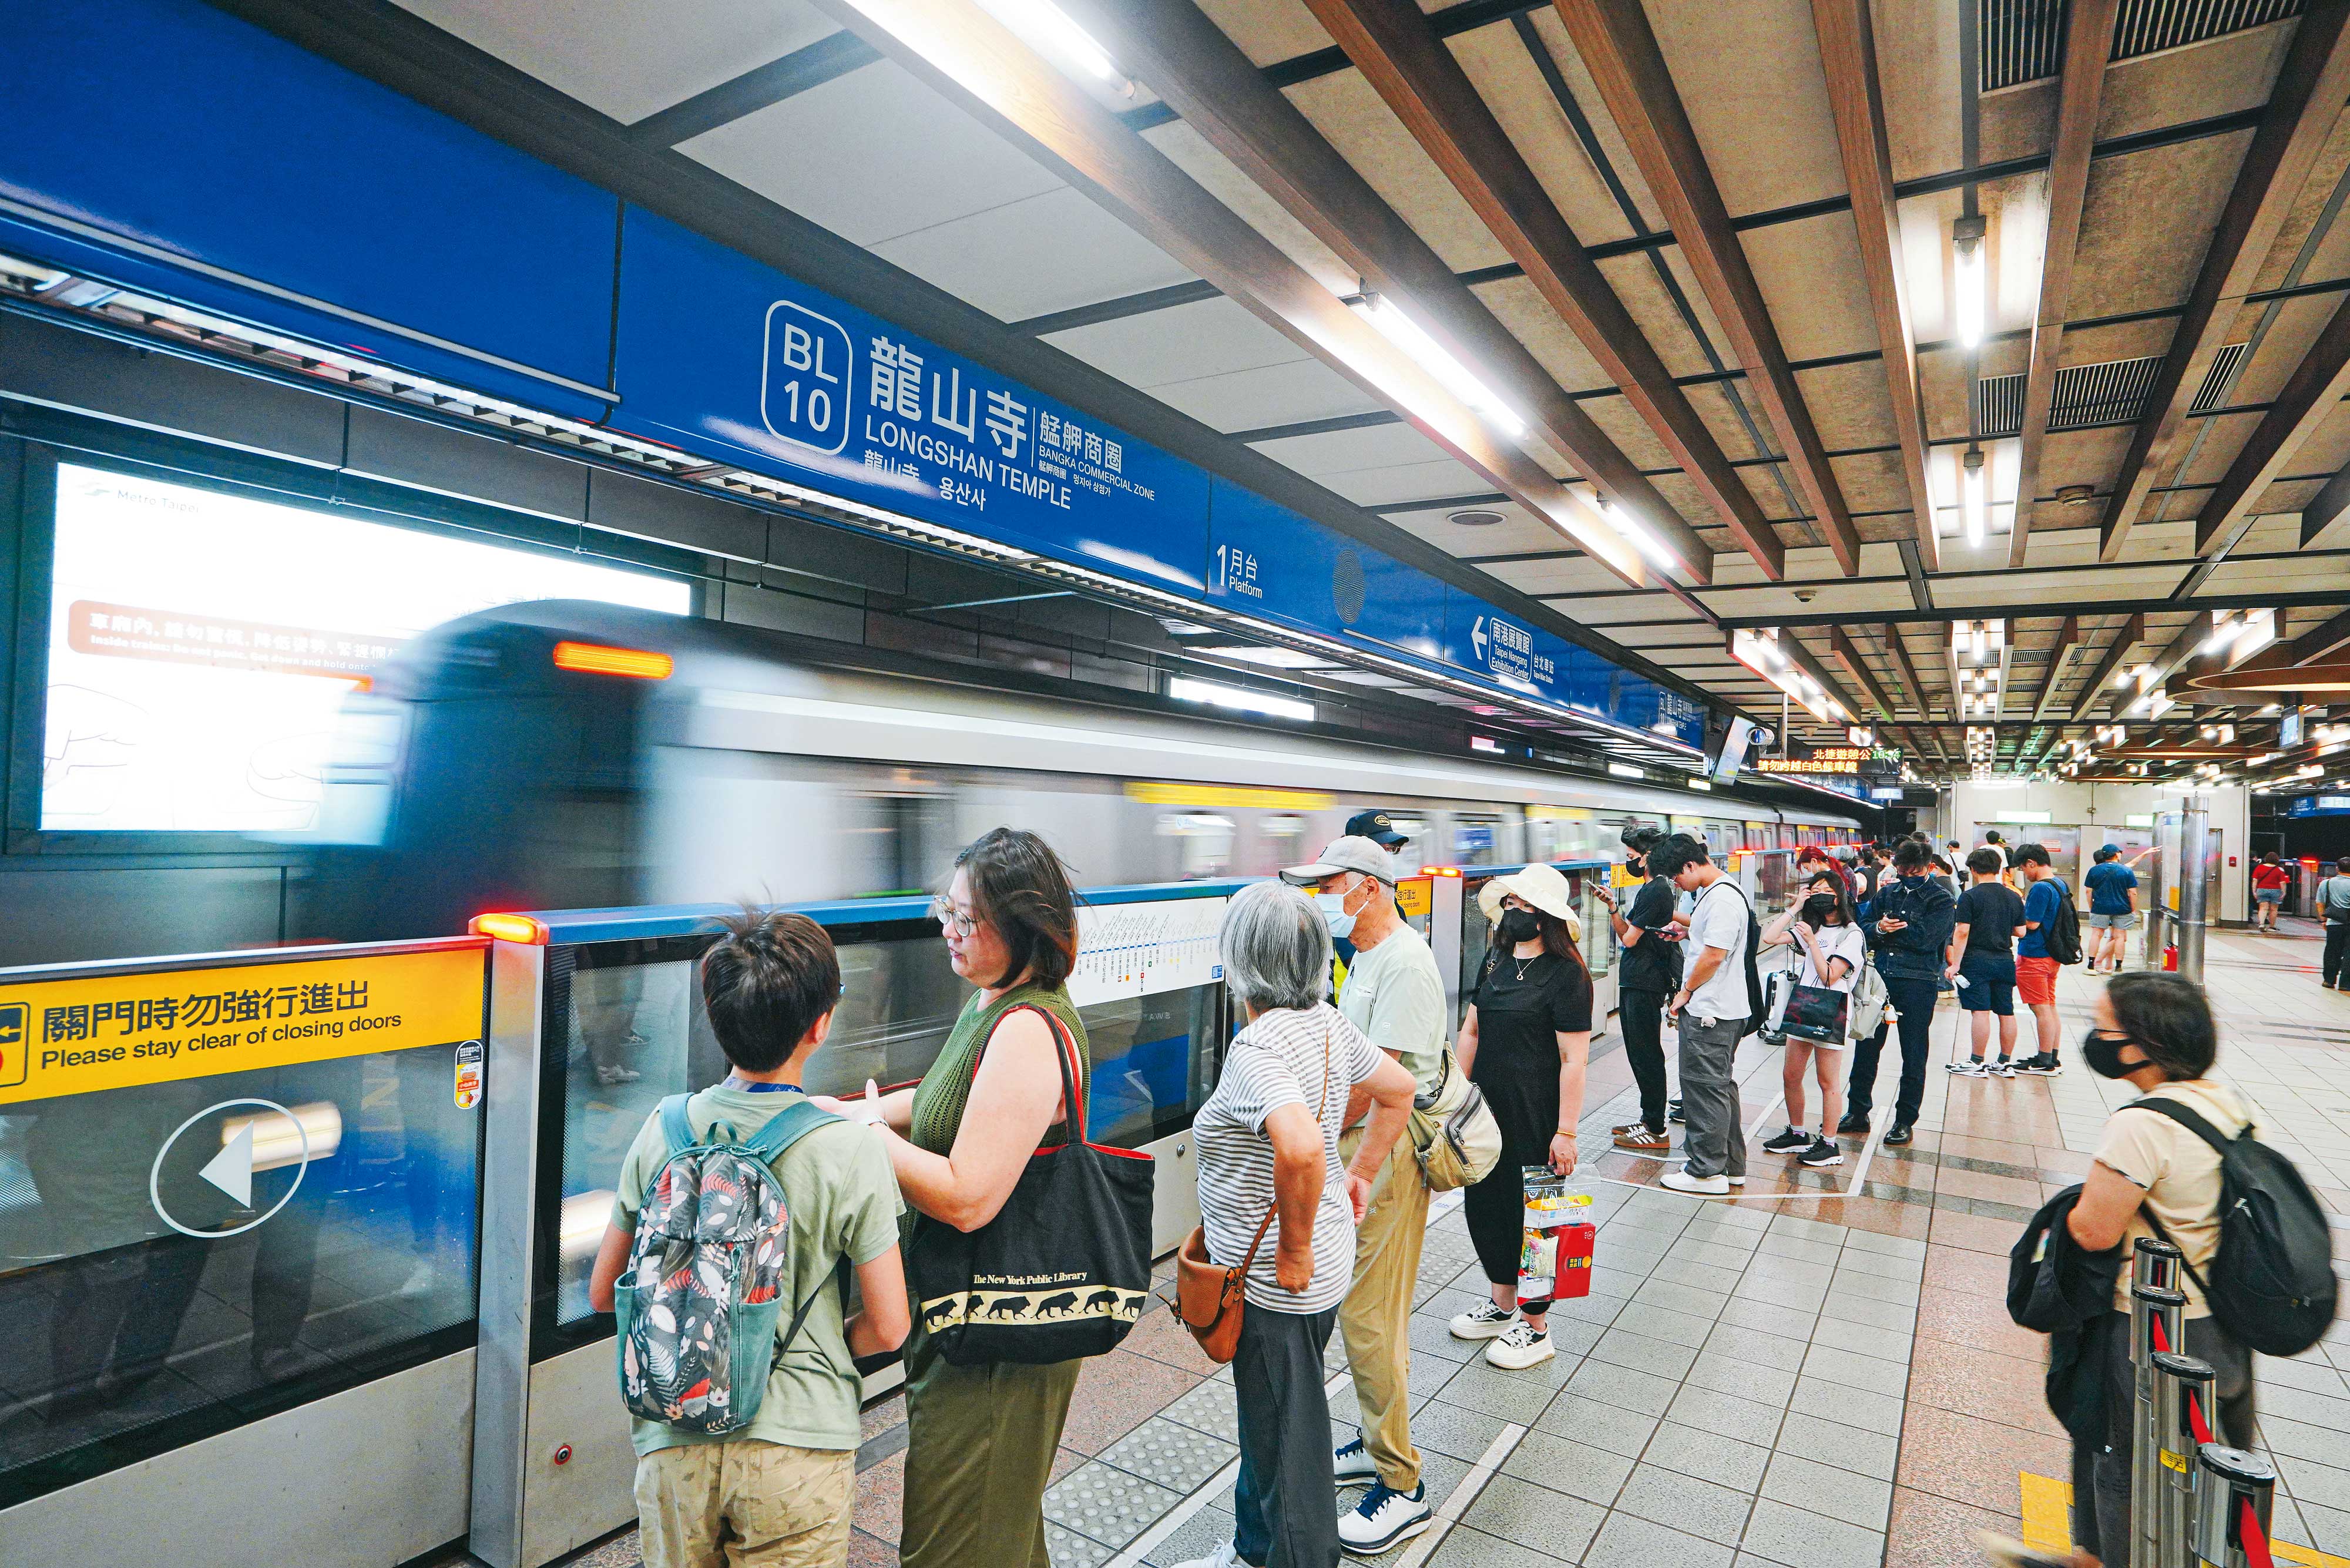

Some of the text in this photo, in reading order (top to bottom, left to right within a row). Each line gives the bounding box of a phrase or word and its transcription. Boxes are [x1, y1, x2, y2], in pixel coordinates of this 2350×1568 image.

[783, 323, 838, 385] BL
[784, 380, 831, 432] 10
[870, 335, 1028, 459] 龍山寺
[1039, 411, 1122, 474] 艋舺商圈
[865, 415, 1072, 510] LONGSHAN TEMPLE
[1039, 445, 1155, 501] BANGKA COMMERCIAL ZONE
[118, 489, 199, 513] Metro Taipei
[939, 476, 986, 511] 용산사
[1093, 481, 1111, 498] 상점가
[1229, 575, 1263, 599] Platform
[91, 635, 128, 647] Inside
[271, 654, 300, 665] down
[302, 658, 321, 667] and
[324, 660, 345, 669] hold
[1493, 622, 1530, 655] 南港展覽館
[1492, 656, 1529, 680] Exhibition Center
[1494, 644, 1528, 669] Taipei Nangang
[1533, 653, 1554, 674] 台北車站
[1757, 760, 1858, 774] 請勿跨越白色候車線
[42, 980, 369, 1044] 關門時勿強行進出
[41, 1012, 402, 1070] Please stay clear of closing doors
[973, 1271, 1087, 1285] The New York Public Library
